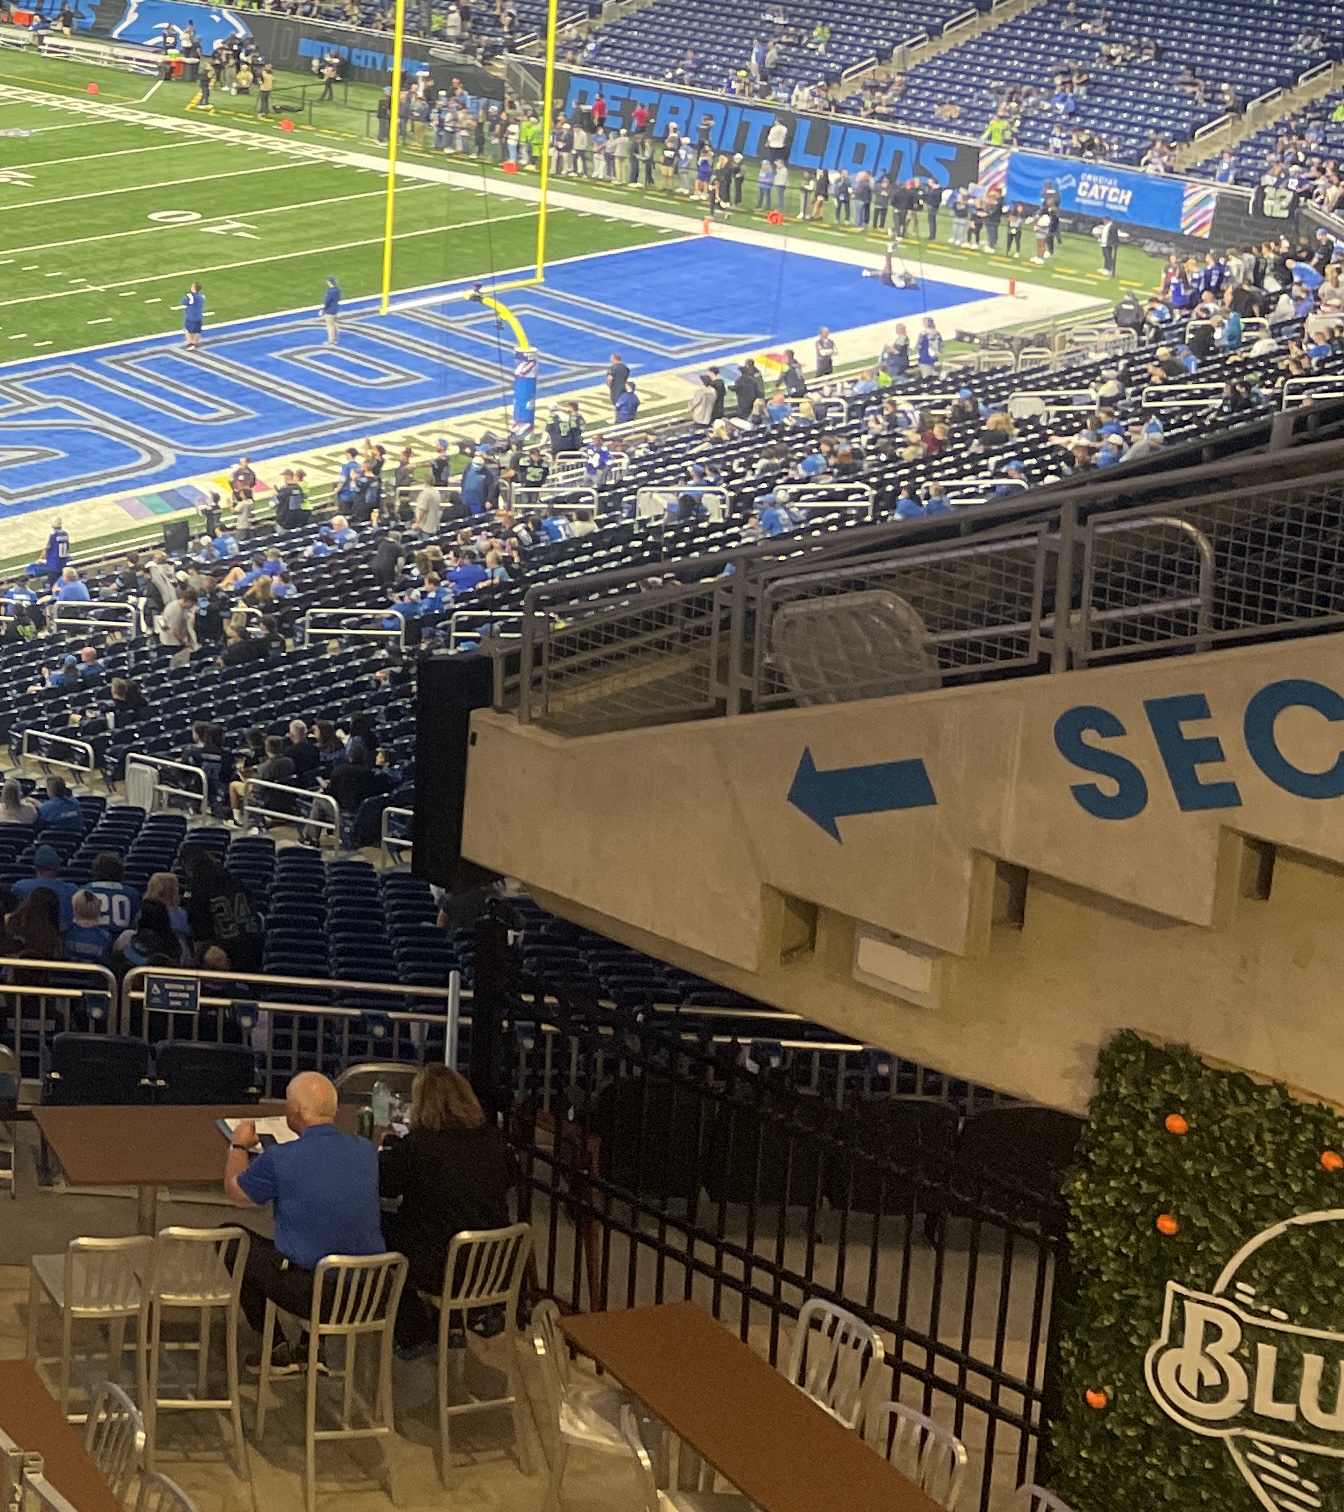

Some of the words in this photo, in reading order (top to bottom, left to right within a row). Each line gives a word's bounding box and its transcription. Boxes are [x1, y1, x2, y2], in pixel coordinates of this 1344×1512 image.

[171, 123, 351, 160] CANCER
[784, 116, 960, 190] LIONS
[1077, 181, 1132, 206] CATCH
[1053, 678, 1344, 821] SEC
[1157, 1300, 1344, 1433] BLU
